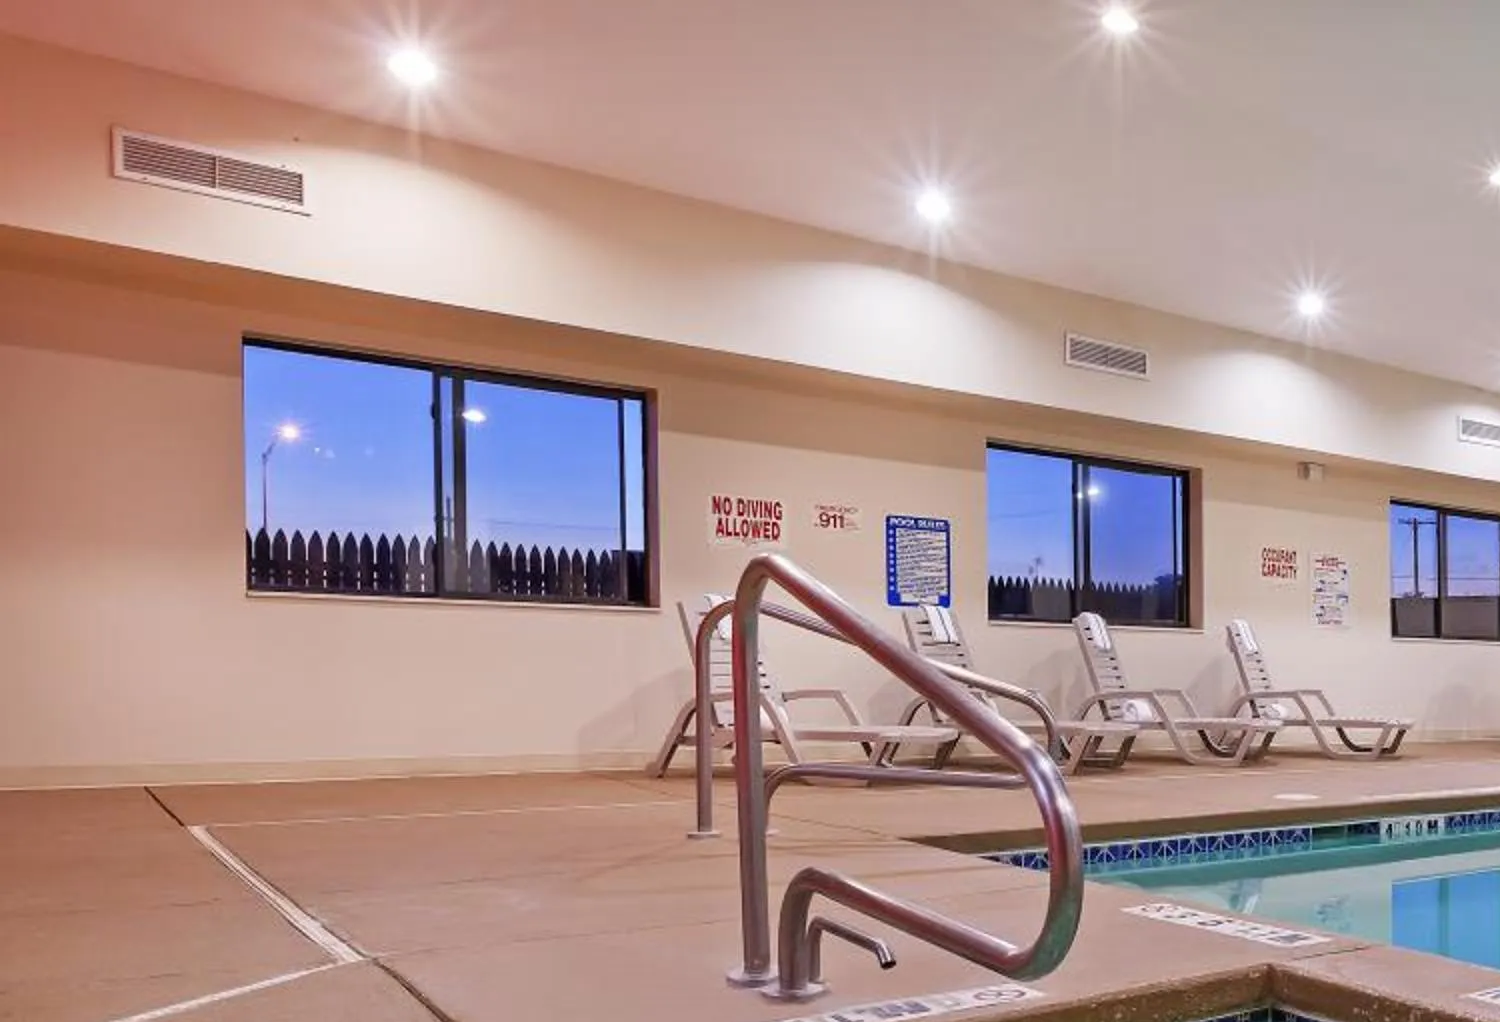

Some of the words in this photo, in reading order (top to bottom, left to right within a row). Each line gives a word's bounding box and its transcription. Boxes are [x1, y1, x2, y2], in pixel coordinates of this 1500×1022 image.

[712, 495, 732, 516] NO
[737, 497, 783, 521] DIVING
[819, 511, 845, 529] 911
[716, 517, 781, 541] ALLOWED
